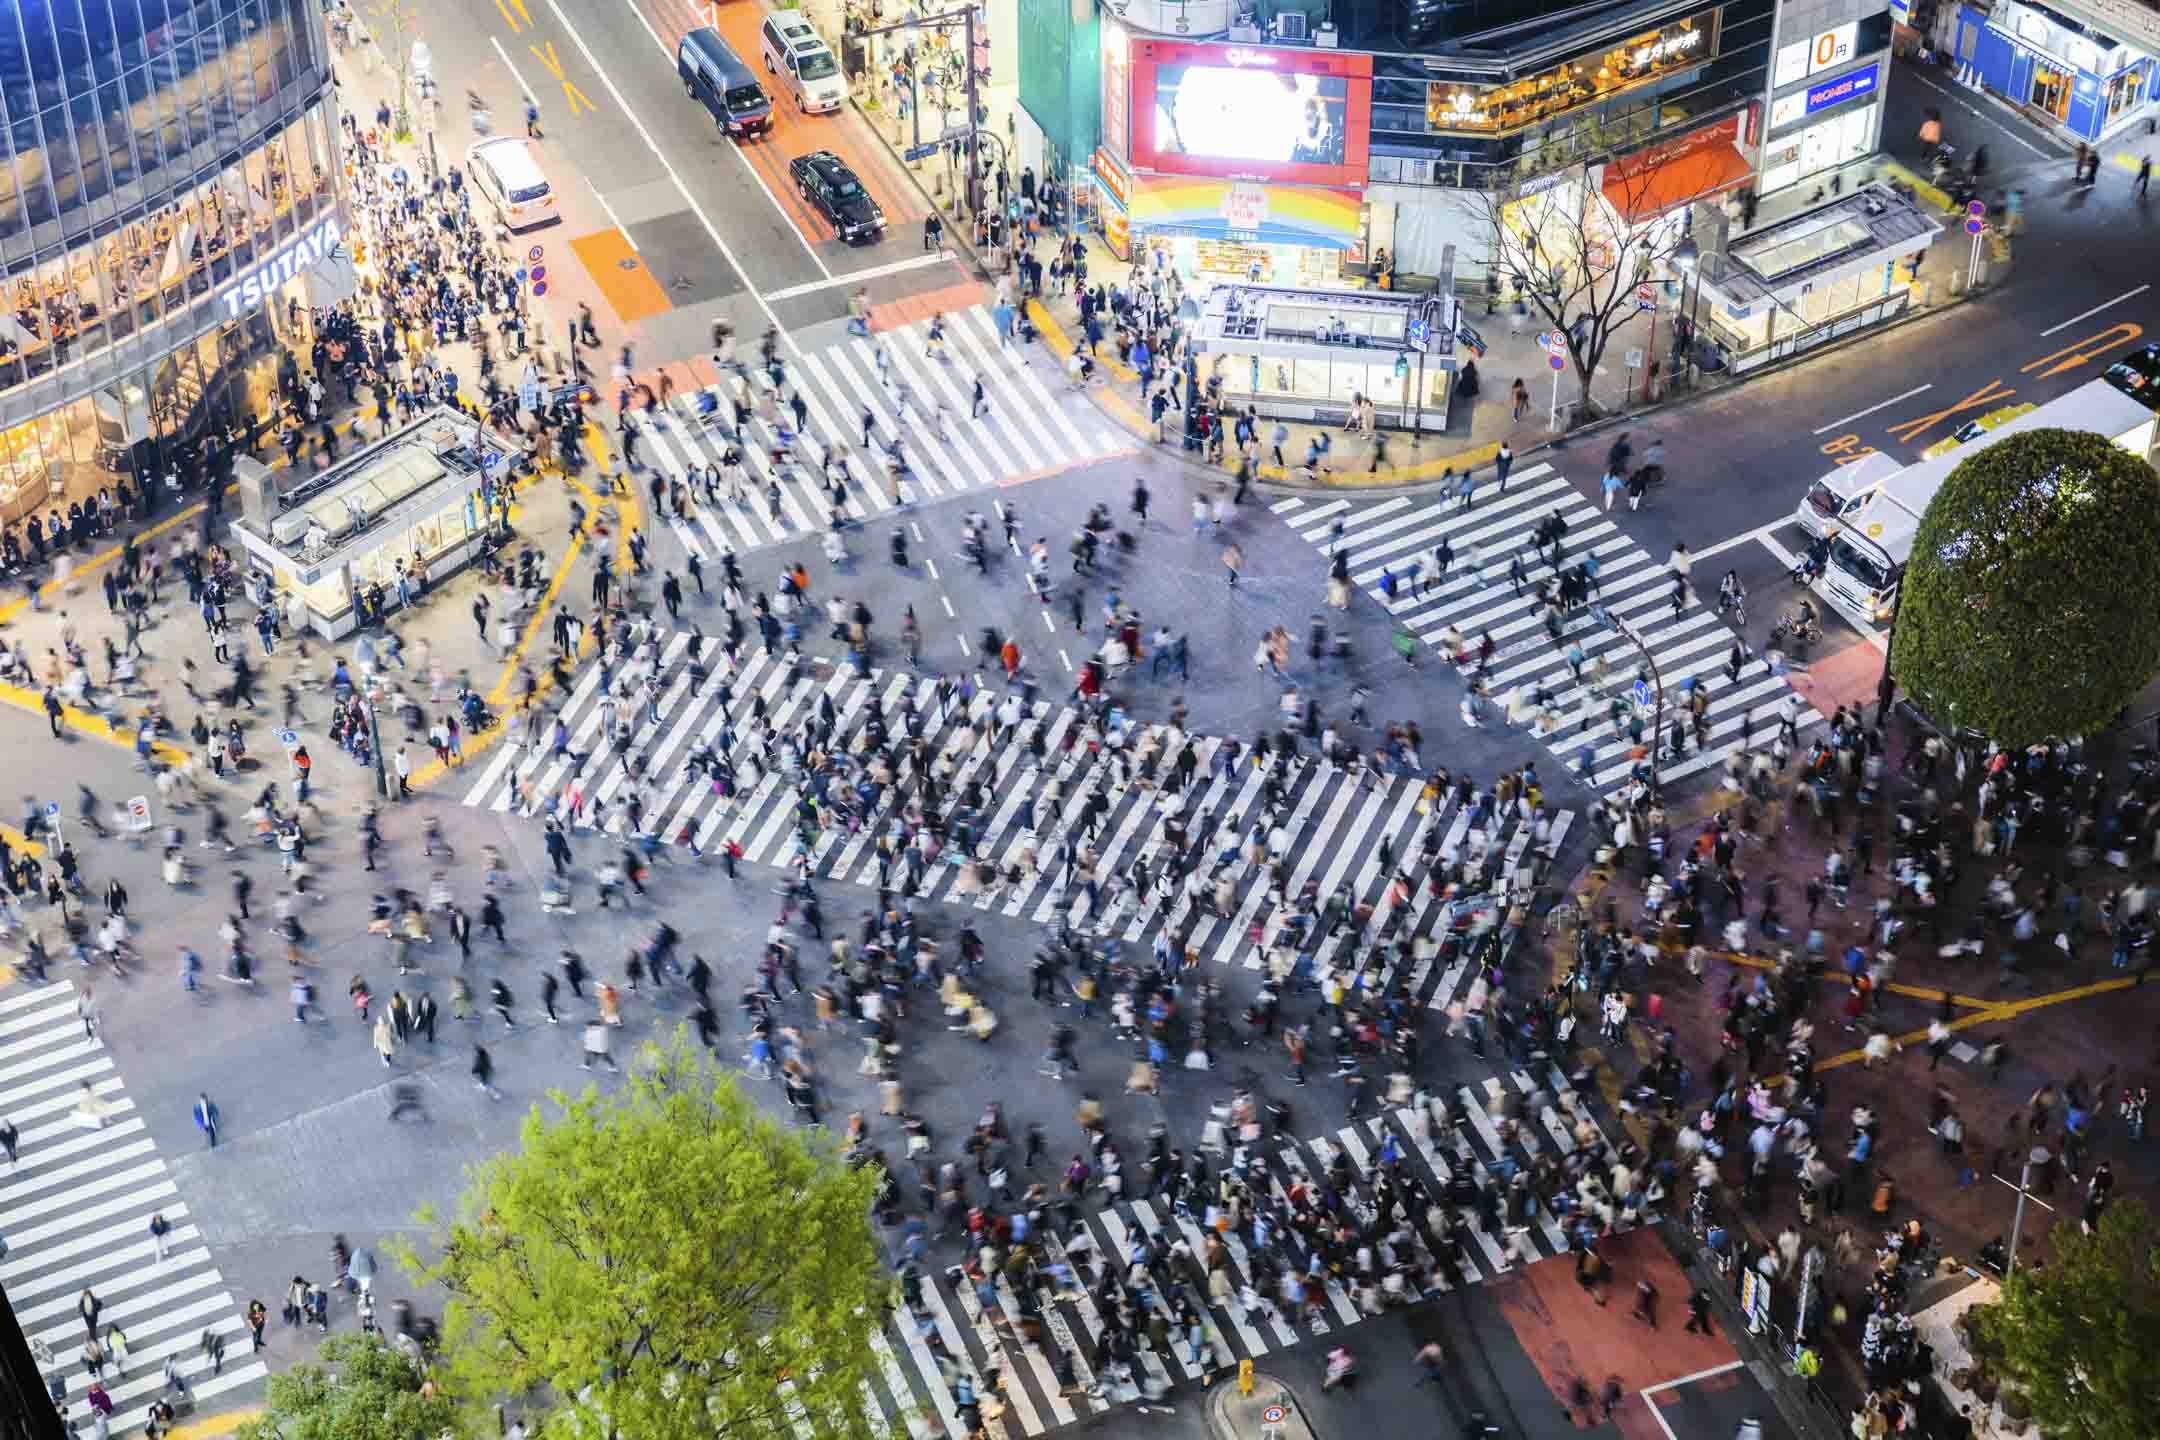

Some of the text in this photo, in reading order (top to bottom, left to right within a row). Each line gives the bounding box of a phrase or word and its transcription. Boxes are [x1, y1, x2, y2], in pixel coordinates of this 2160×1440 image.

[1816, 32, 1847, 65] 0円
[1810, 80, 1853, 105] PROMISE
[222, 218, 341, 318] TSUTAYA
